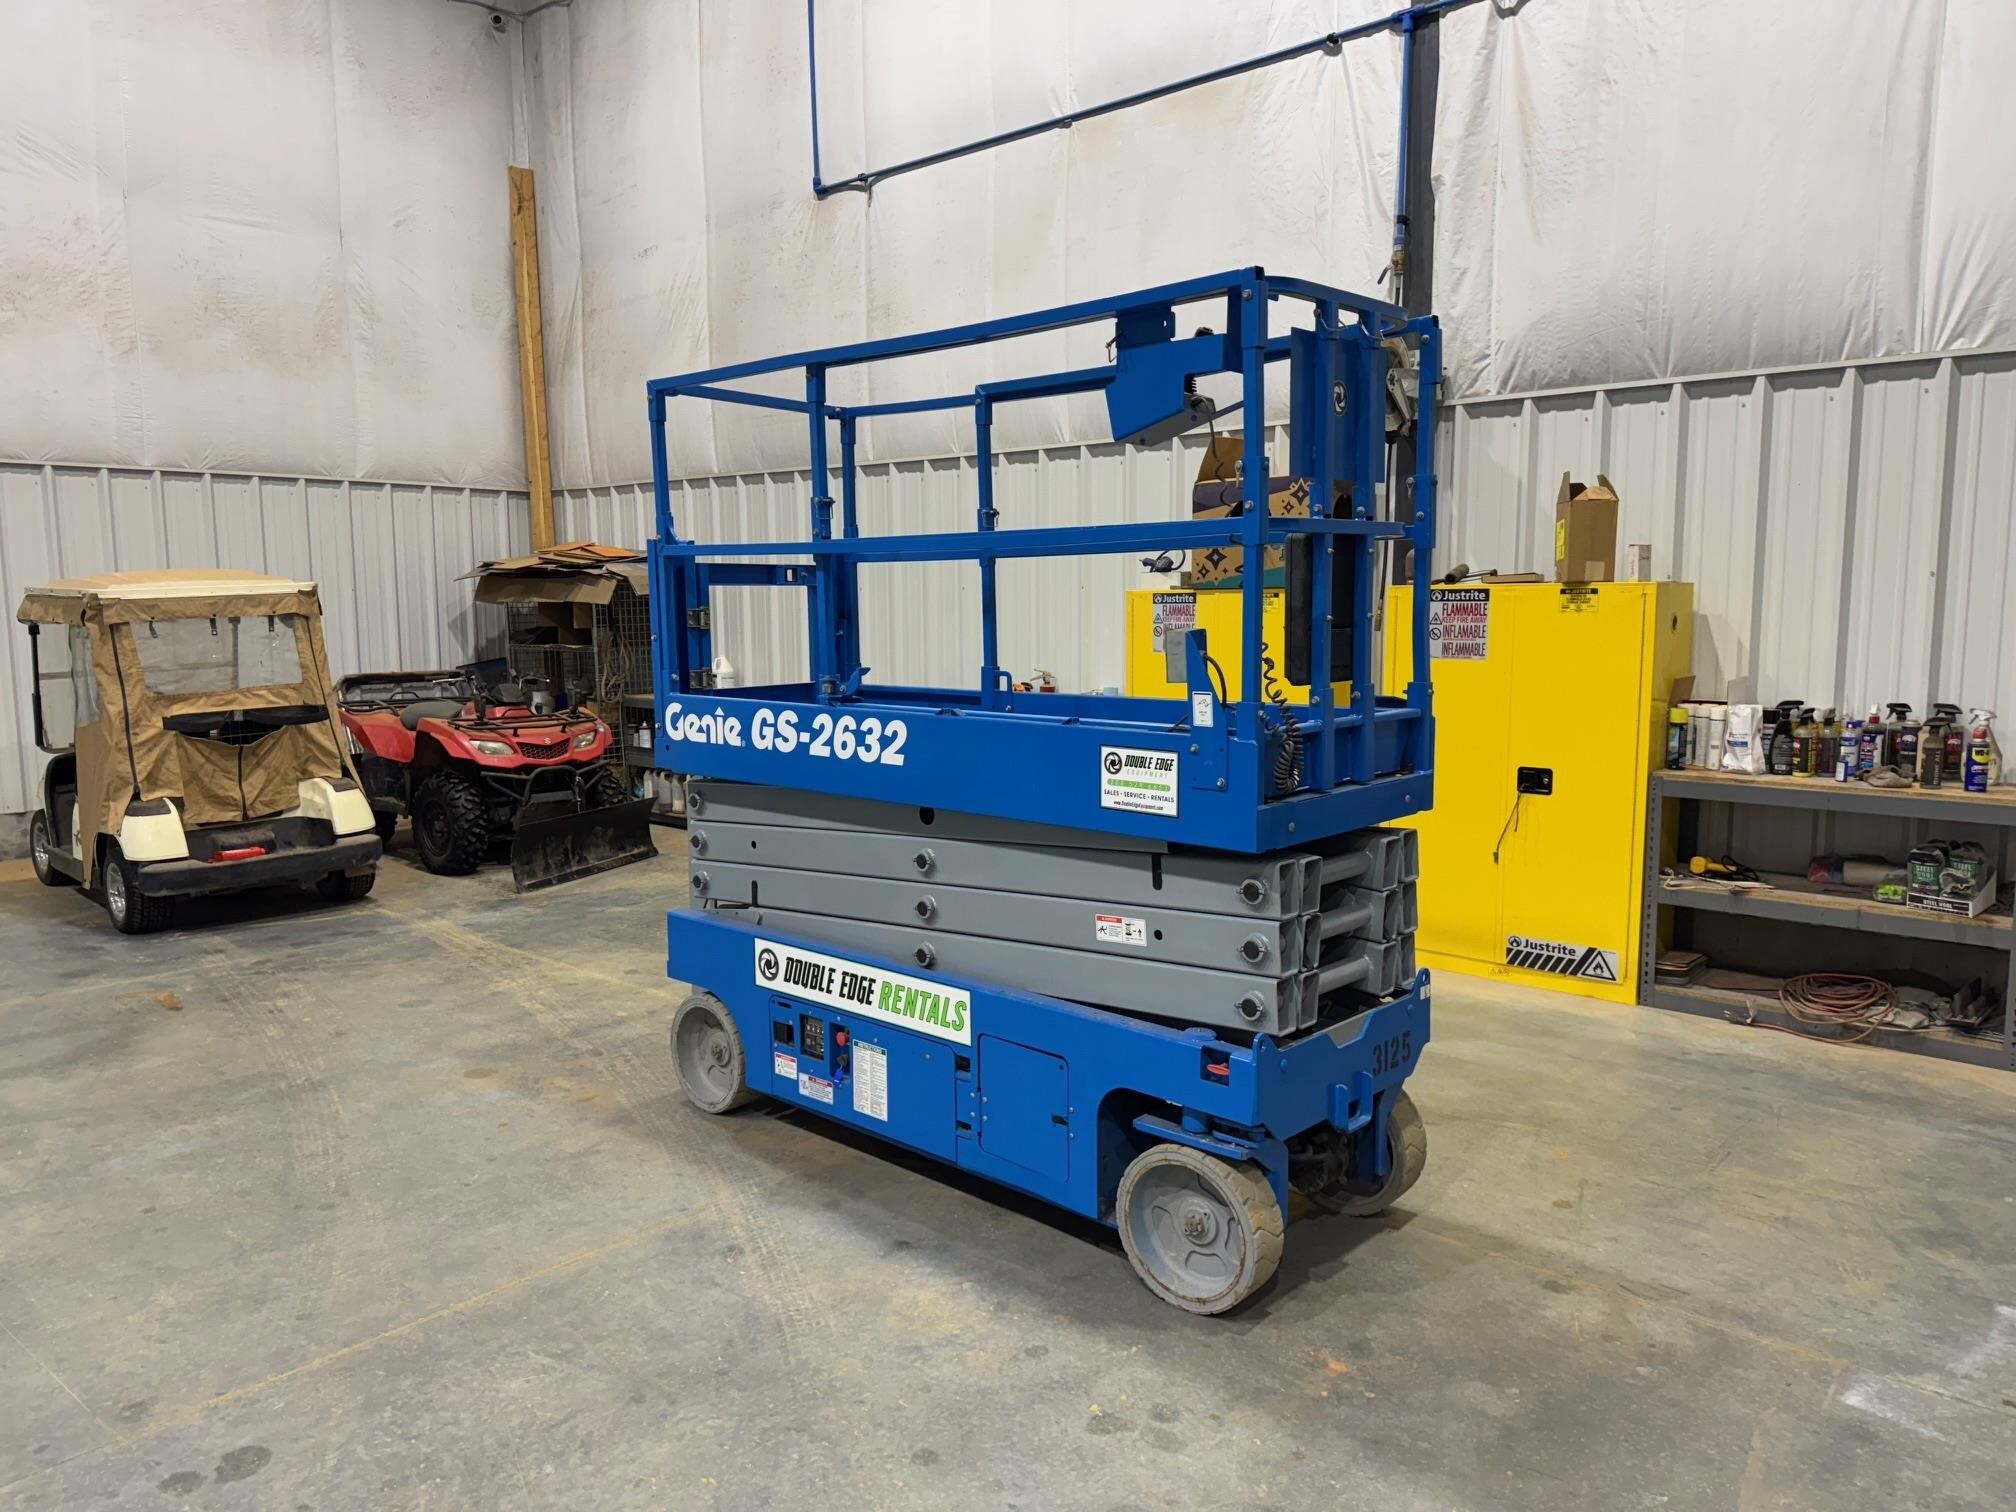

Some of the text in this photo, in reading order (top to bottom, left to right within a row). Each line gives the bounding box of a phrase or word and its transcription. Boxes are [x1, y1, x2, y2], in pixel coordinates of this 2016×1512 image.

[1162, 594, 1195, 603] Justrite
[1443, 590, 1486, 600] Justrite
[1162, 604, 1196, 617] FLAMMABLE
[1442, 602, 1488, 617] FLAMMABLE
[1442, 616, 1487, 625] KEEP FIRE AWAY
[1442, 625, 1487, 639] INFLAMABLE
[1441, 642, 1486, 657] INFLAMMABLE
[665, 702, 908, 766] Genie GS-2632
[1124, 754, 1175, 772] DOUBLE EDGE
[1123, 791, 1146, 800] SERVICE
[1150, 794, 1175, 803] RENTALS
[1523, 938, 1576, 957] Justrite
[783, 956, 968, 1032] DOUBLE EDGE RENTALS
[1372, 1030, 1411, 1076] 3125
